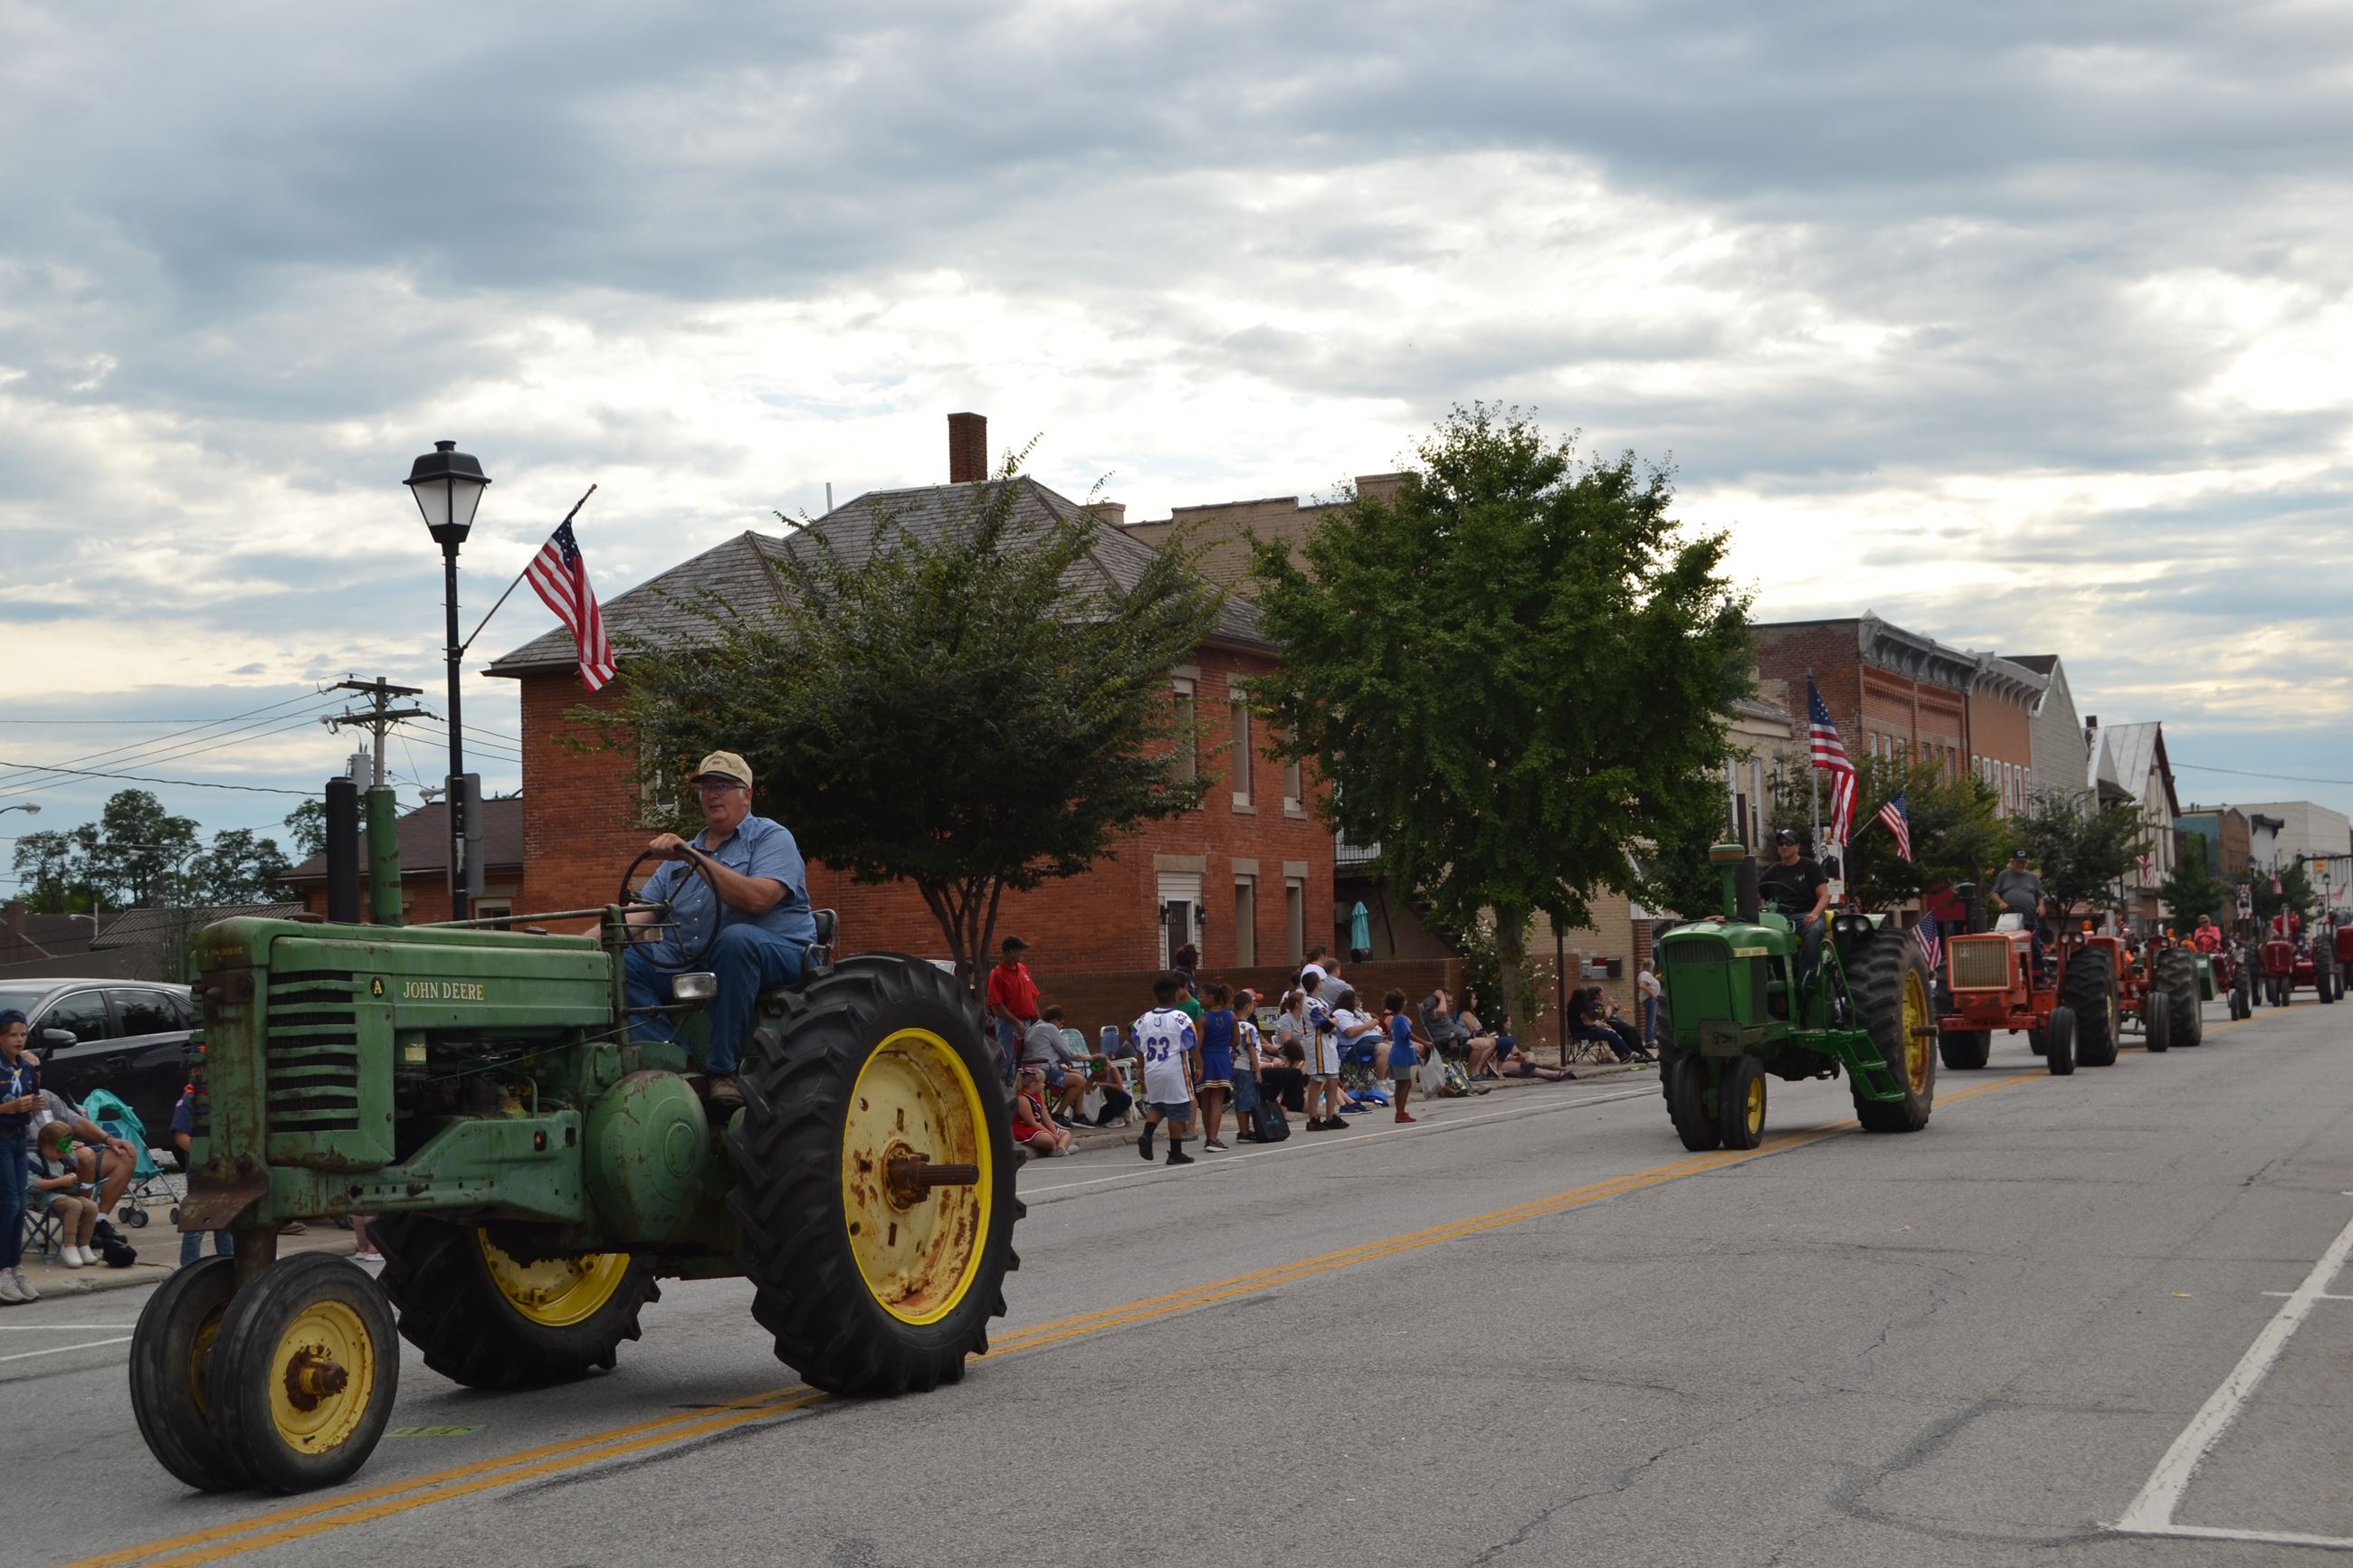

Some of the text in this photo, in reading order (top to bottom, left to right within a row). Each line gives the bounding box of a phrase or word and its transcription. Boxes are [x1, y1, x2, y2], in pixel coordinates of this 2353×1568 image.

[373, 980, 383, 994] A
[403, 981, 484, 1001] JOHN DEERE
[1147, 1036, 1170, 1062] 63
